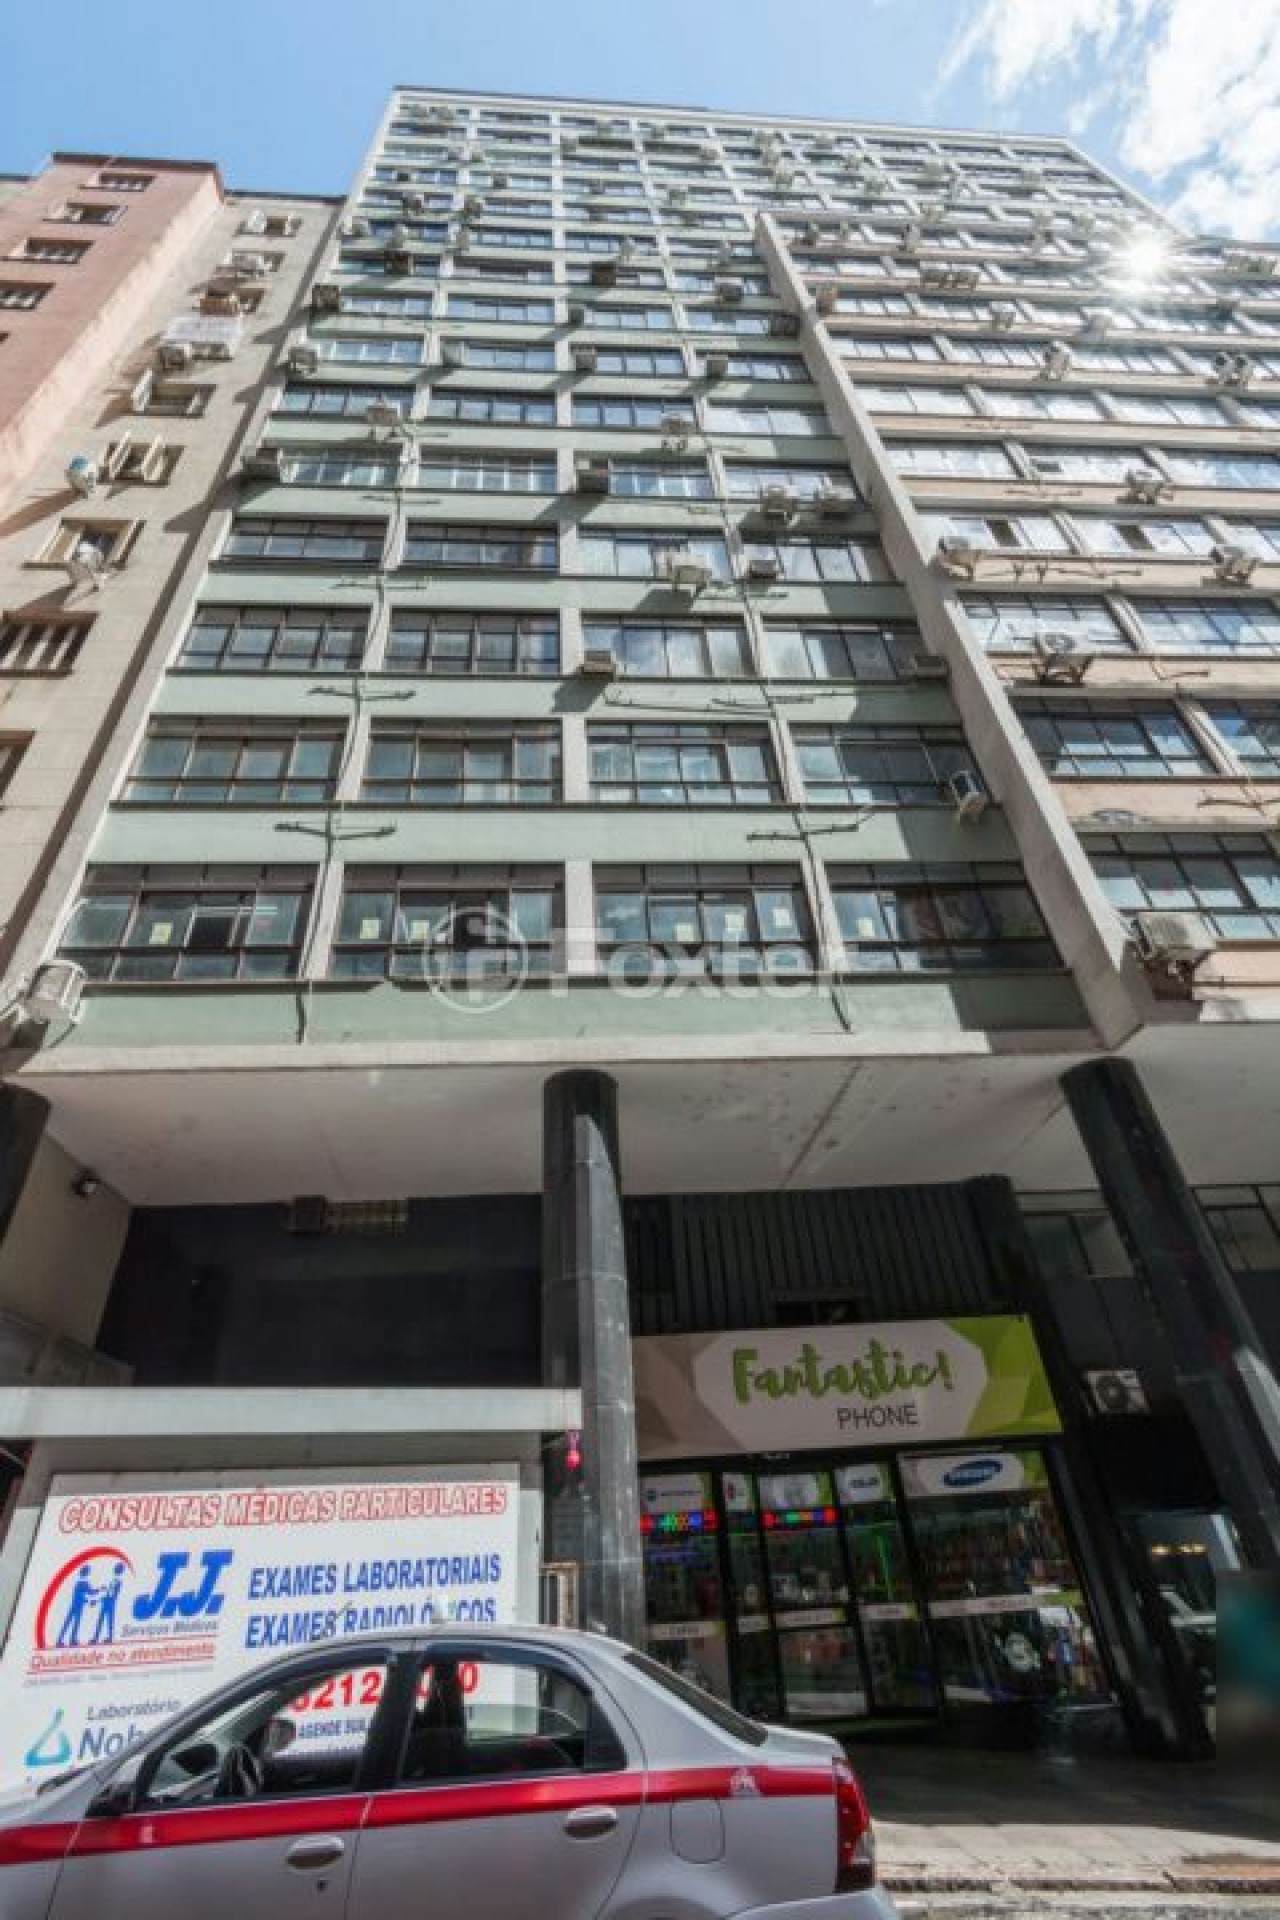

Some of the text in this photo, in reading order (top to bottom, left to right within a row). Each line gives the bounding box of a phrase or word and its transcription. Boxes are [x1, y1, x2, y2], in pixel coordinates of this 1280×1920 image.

[733, 1337, 954, 1405] Fantastic!
[836, 1403, 918, 1429] PHONE
[59, 1485, 507, 1533] CONSULTAS MÉDICAS PARTICULARES
[132, 1549, 235, 1620] J.J.
[247, 1553, 501, 1600] EXAMES LABORATORIAIS
[245, 1610, 337, 1648] EXAMES
[31, 1643, 214, 1671] Qualidade no atendimento
